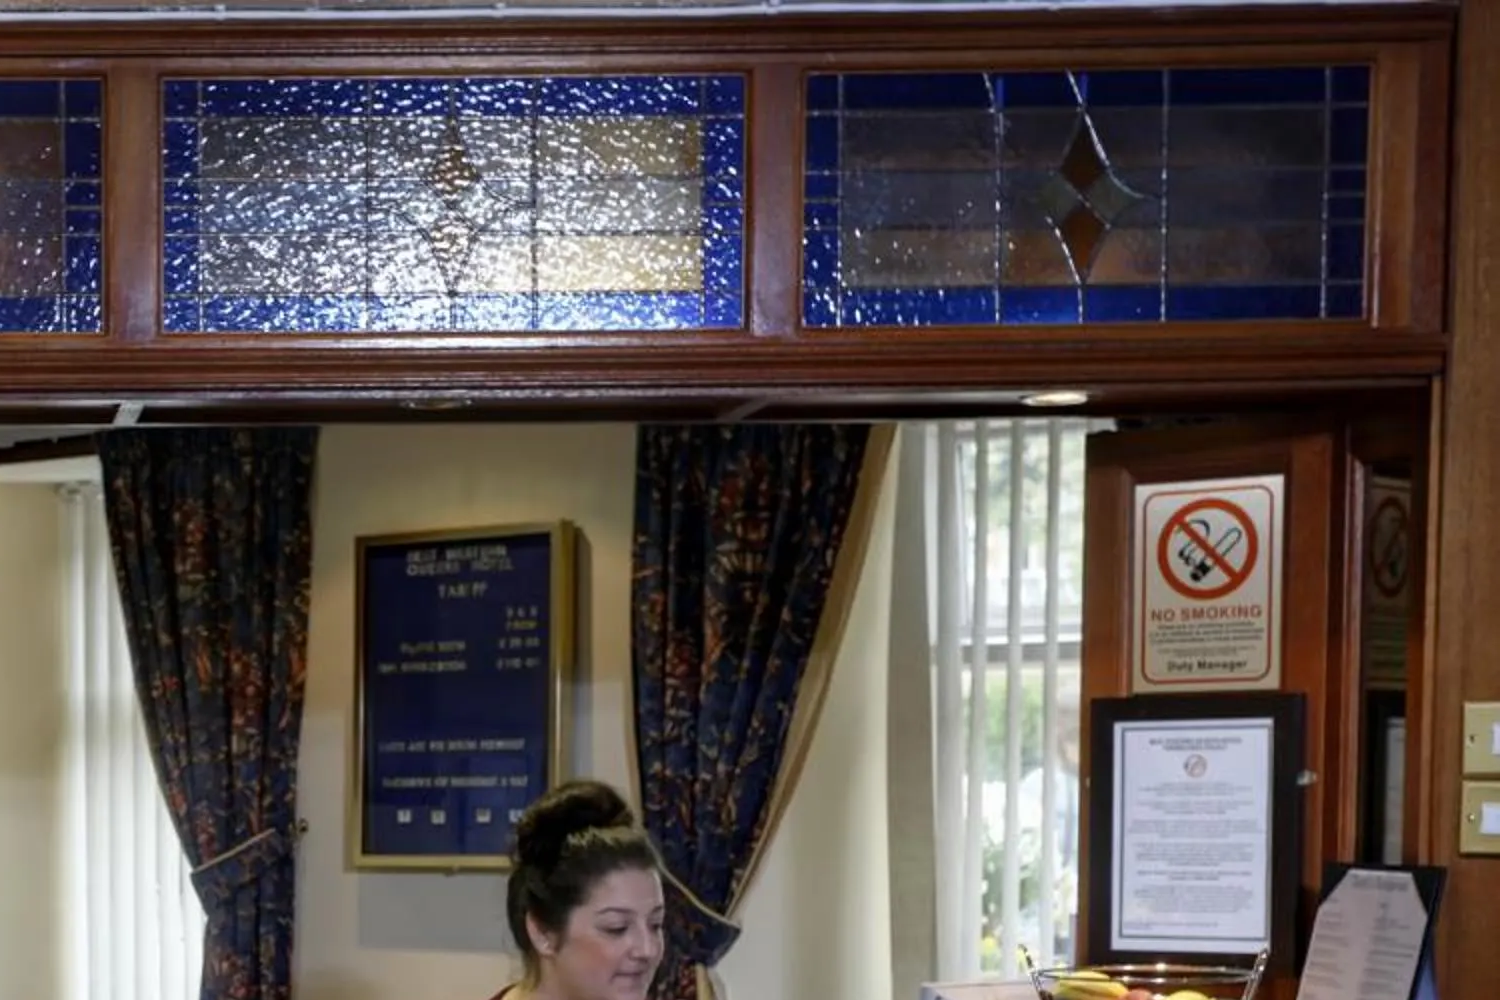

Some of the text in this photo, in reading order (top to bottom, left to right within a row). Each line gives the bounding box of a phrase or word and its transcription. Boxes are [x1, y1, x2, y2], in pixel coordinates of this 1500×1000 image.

[1151, 604, 1262, 621] NO SMOKING
[1167, 659, 1247, 672] Duty Manager
